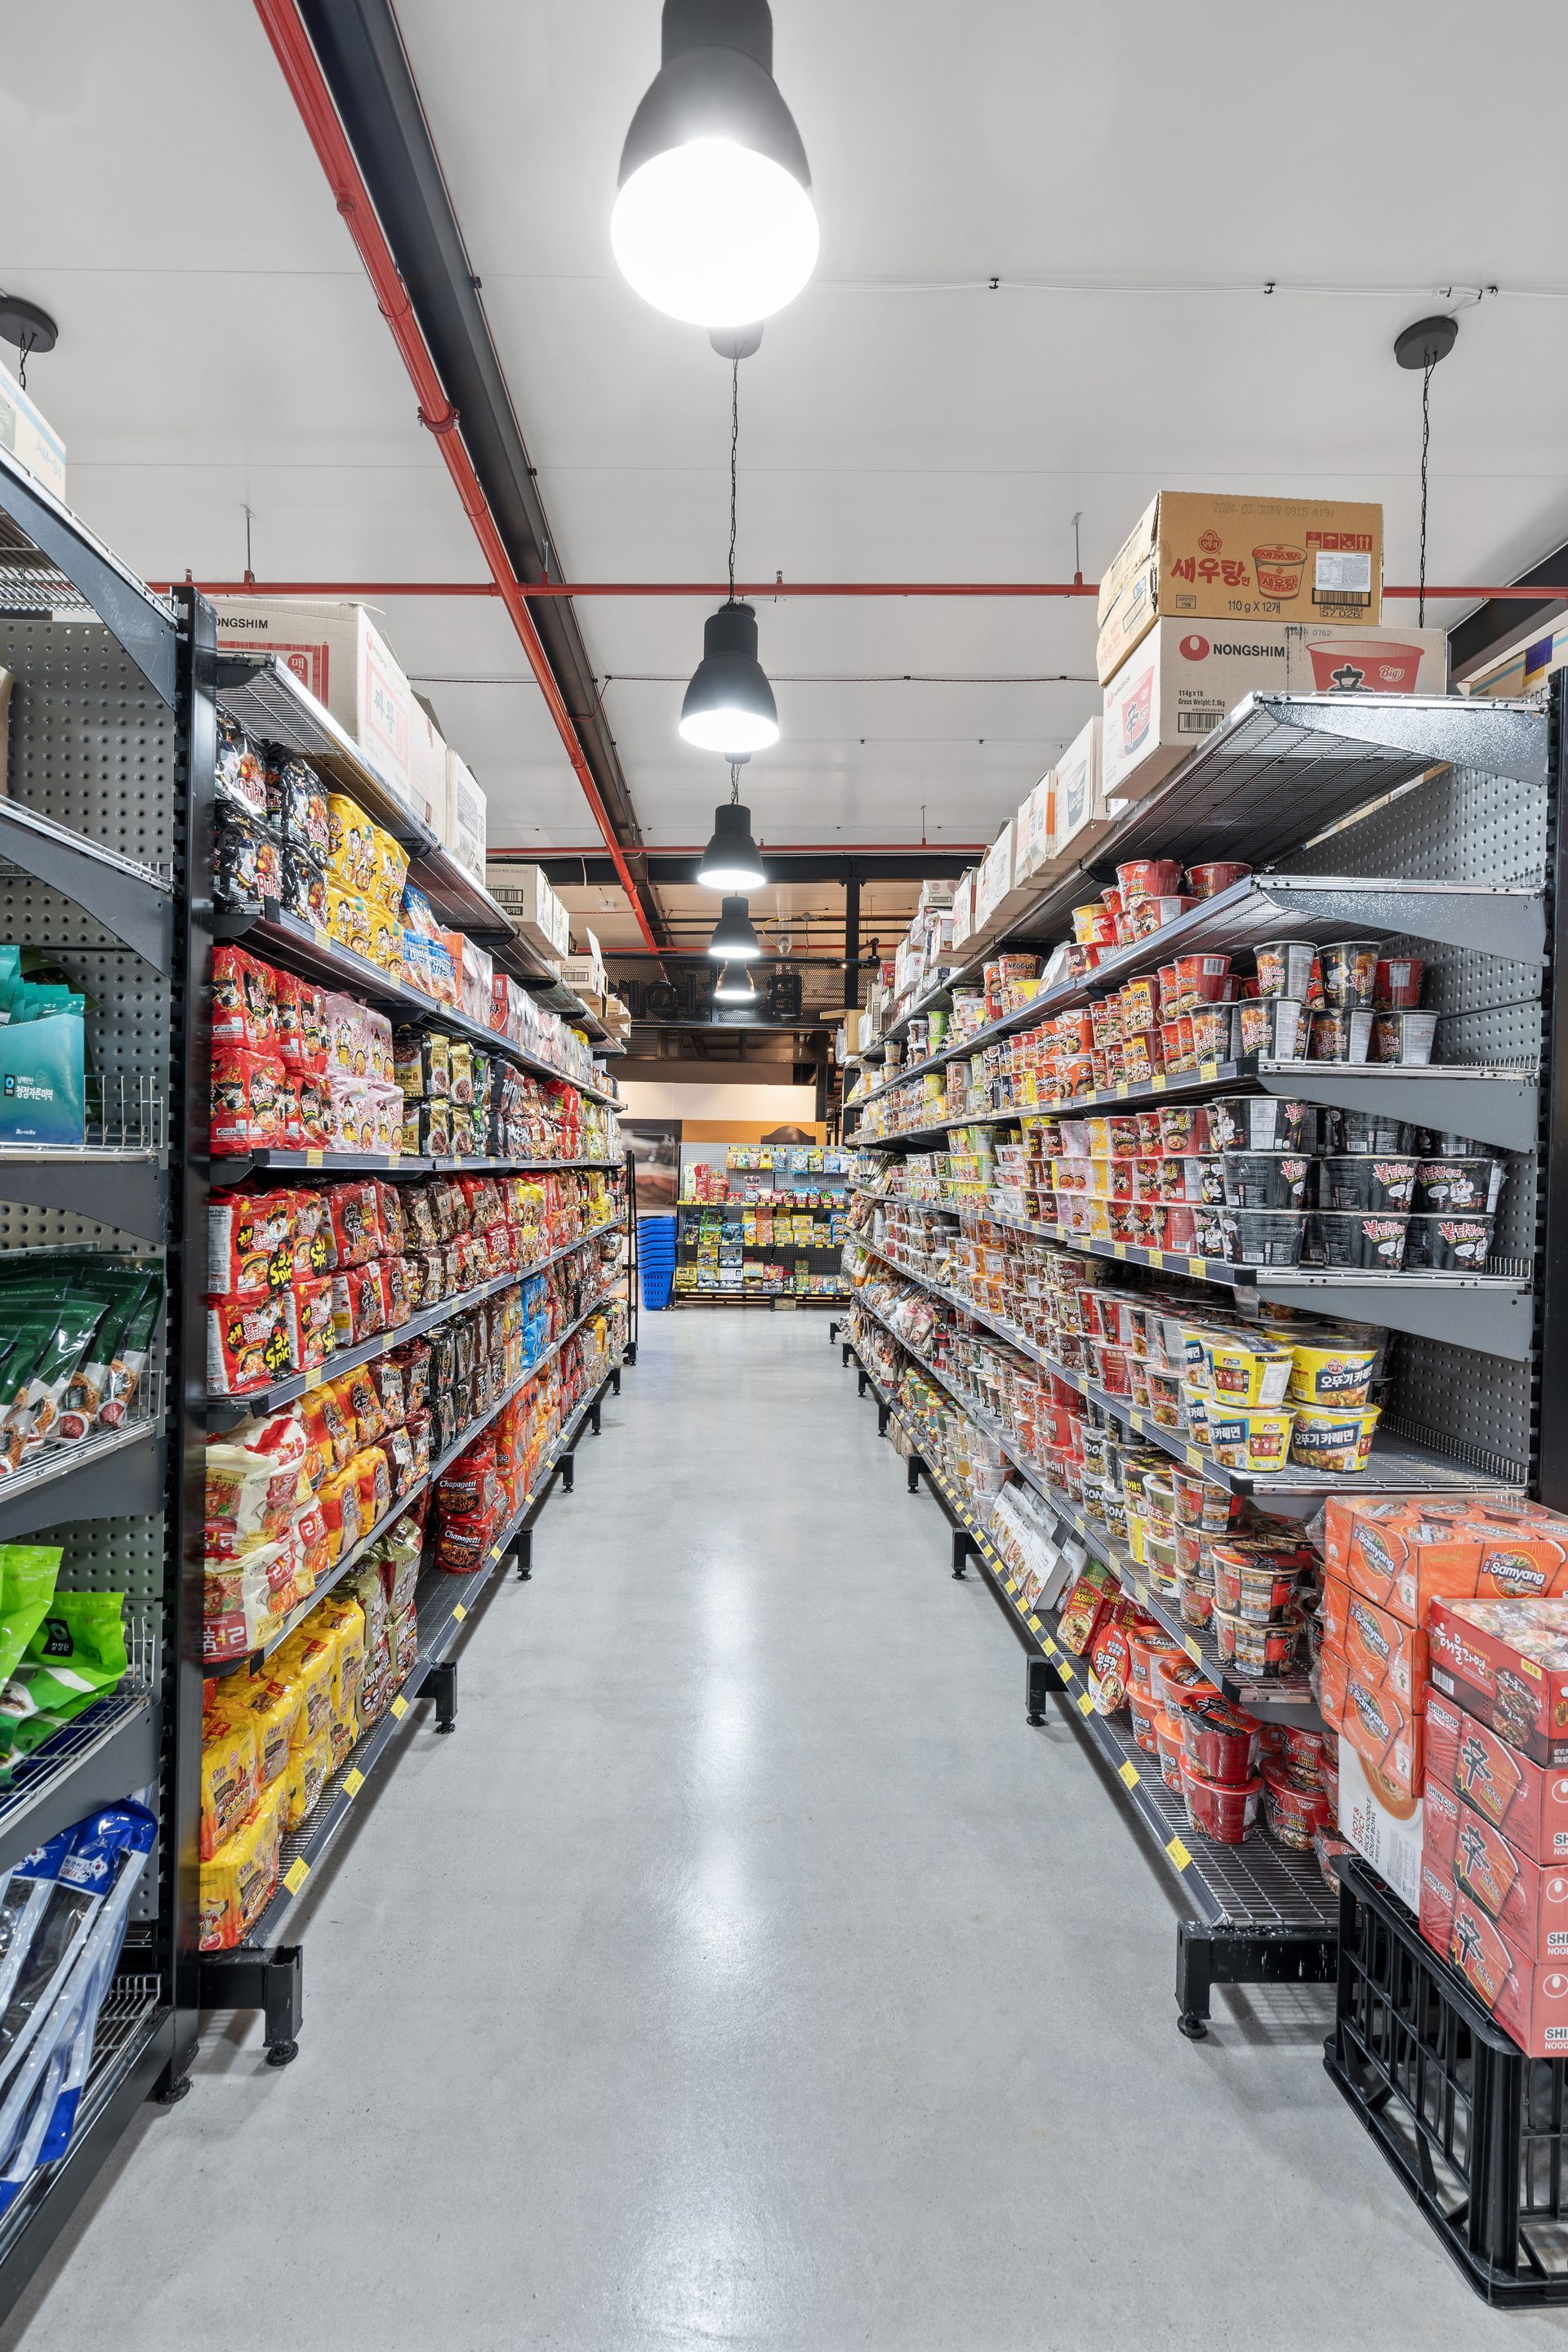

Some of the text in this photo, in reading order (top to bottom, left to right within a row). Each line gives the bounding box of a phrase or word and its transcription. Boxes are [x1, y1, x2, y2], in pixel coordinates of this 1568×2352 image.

[1262, 576, 1296, 590] 새우탕
[1227, 600, 1281, 613] 110 g X 12개
[1339, 610, 1361, 618] 026
[1213, 644, 1285, 657] NONGSHIM
[1380, 666, 1401, 680] Big
[1008, 962, 1035, 970] NEOGURI
[1263, 965, 1285, 975] Buldak
[1204, 1027, 1228, 1037] Buldak
[1248, 1022, 1272, 1032] Buldak
[1321, 1031, 1347, 1042] Buldak
[1416, 1165, 1461, 1183] 불닭볶음면
[1361, 1220, 1405, 1239] 불닭볶음면
[1438, 1222, 1486, 1241] 불닭볶음면
[1320, 1374, 1353, 1389] 오뚜기
[1215, 1427, 1241, 1440] 카레면
[1294, 1430, 1354, 1446] 오뚜기 카레면
[1358, 1531, 1395, 1571] Samyang
[1490, 1561, 1546, 1584] Samyang
[1521, 1582, 1542, 1591] Ramen
[1073, 1592, 1098, 1606] DOSIRAC
[1355, 1610, 1390, 1655] Samyang
[51, 1642, 69, 1651] 청정원
[1353, 1689, 1389, 1736] Samyang
[1428, 1701, 1458, 1727] SHIN CUP
[1306, 1737, 1321, 1747] Big
[1461, 1736, 1492, 1788] 辛
[216, 1775, 251, 1820] Cheese
[1299, 1799, 1314, 1809] Big
[1427, 1784, 1457, 1812] SHIN CUP
[1289, 1820, 1305, 1829] SHIN
[1460, 1824, 1490, 1877] 辛
[1423, 1867, 1452, 1900] SHIN CUP
[1454, 1911, 1486, 1967] 辛
